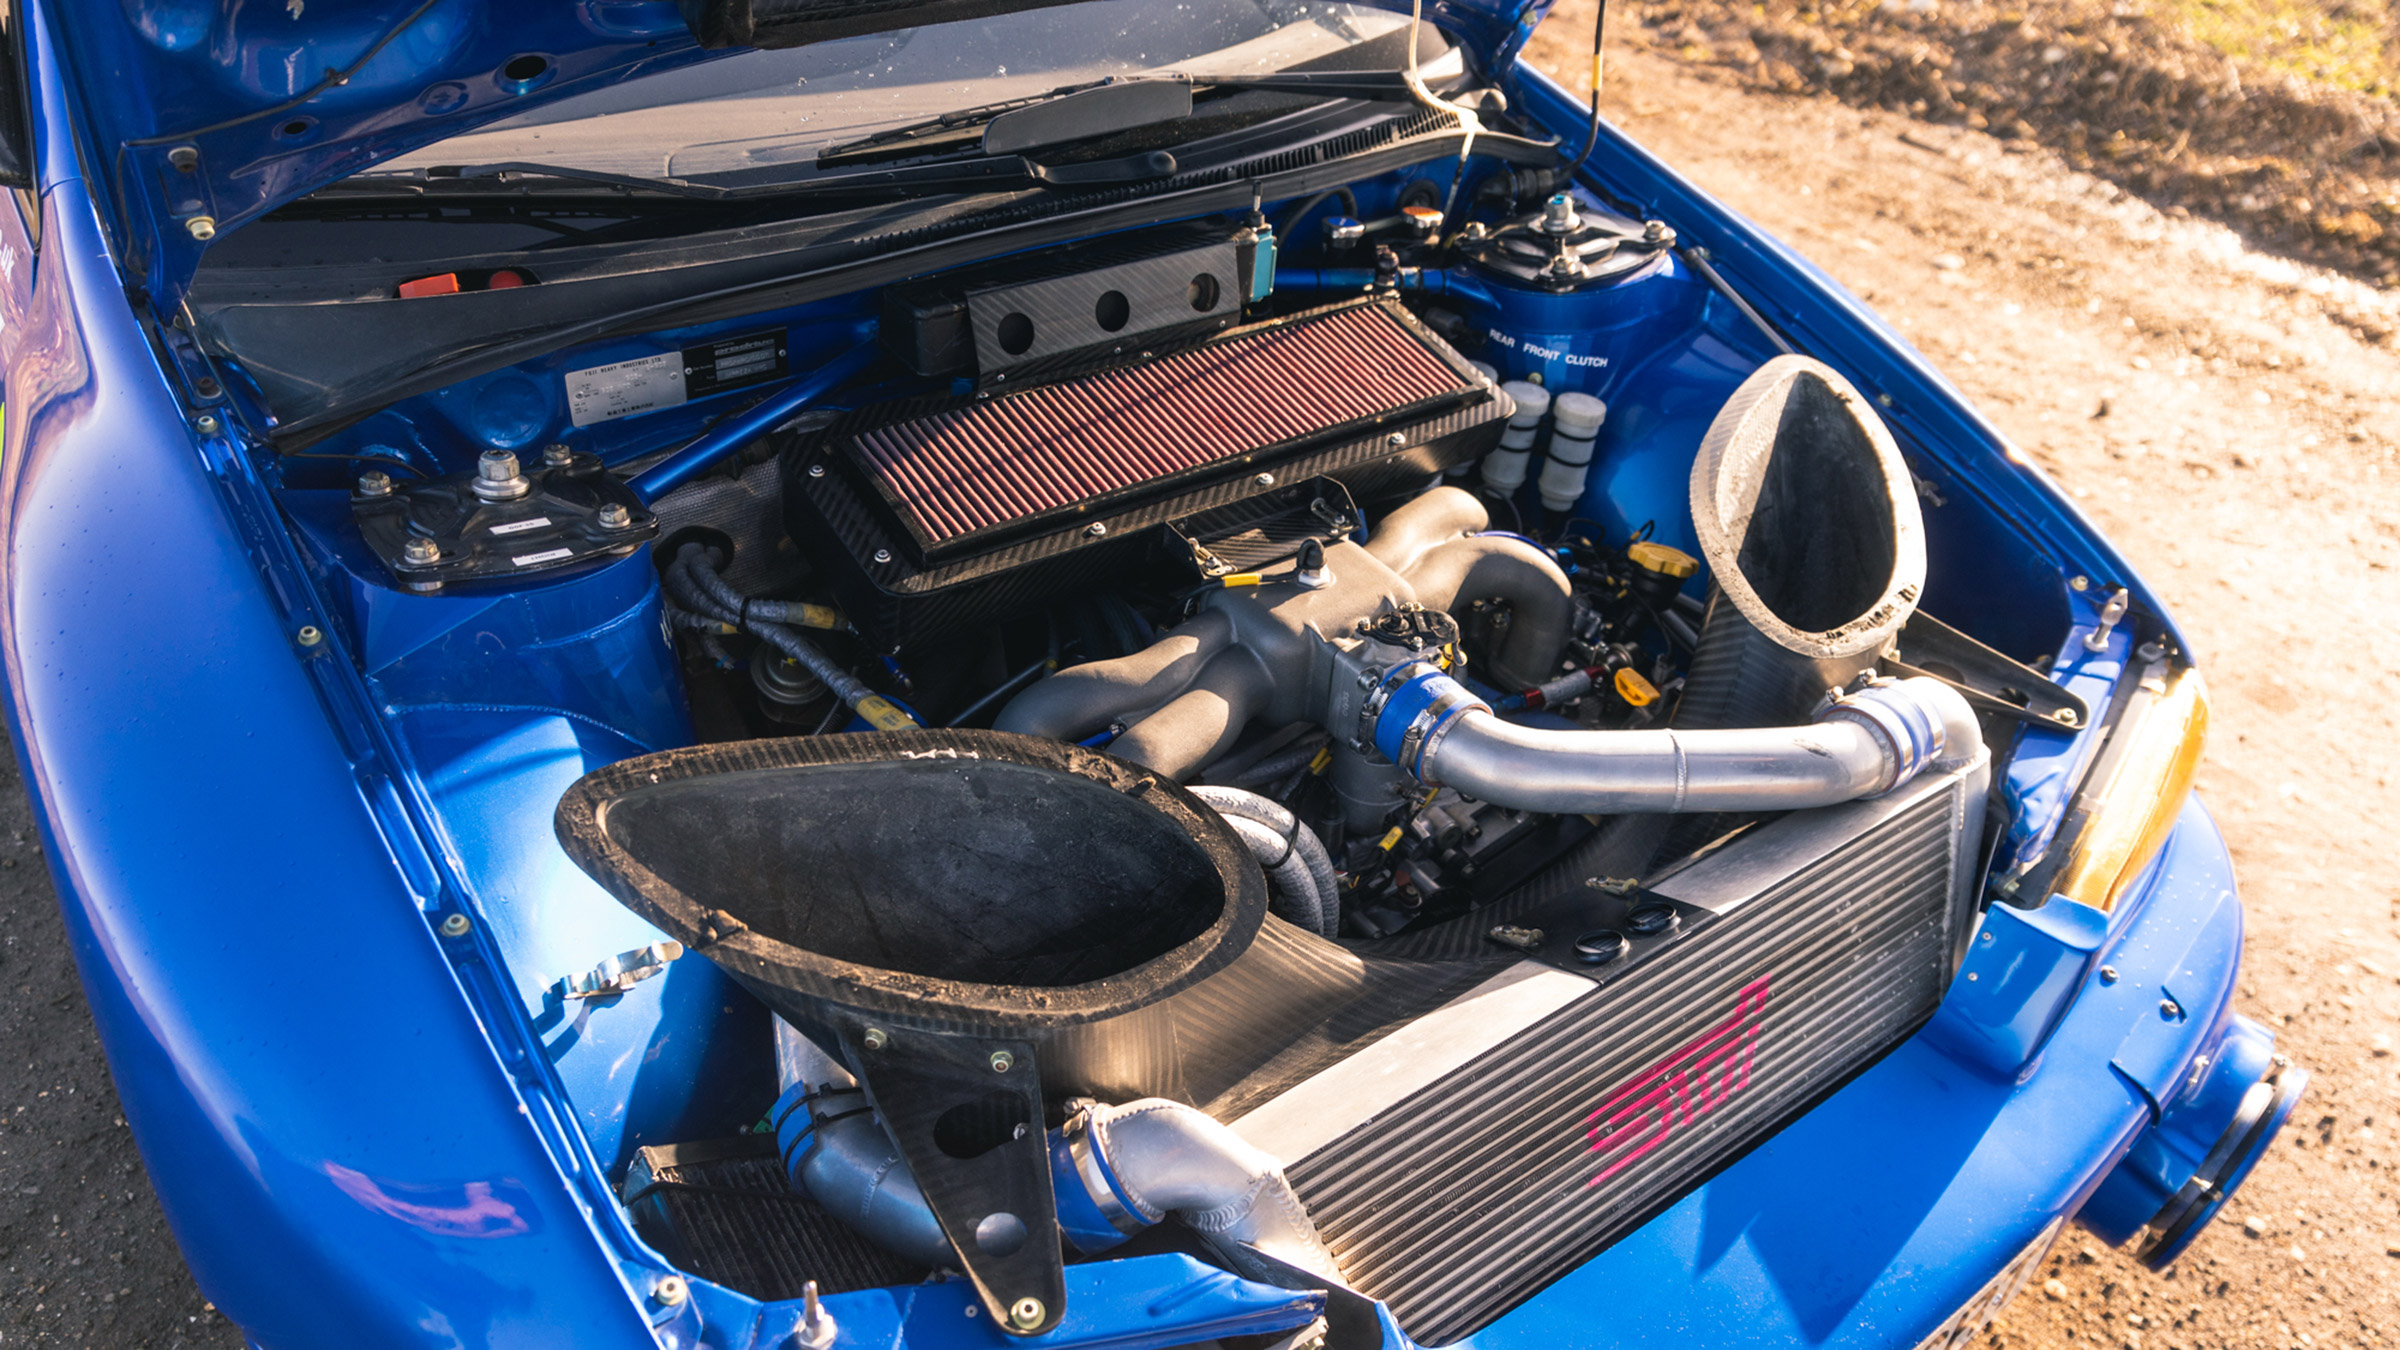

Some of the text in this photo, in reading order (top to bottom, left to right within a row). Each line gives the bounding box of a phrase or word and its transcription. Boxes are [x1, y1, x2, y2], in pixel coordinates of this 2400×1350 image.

[1489, 328, 1608, 367] REAR FRONT CLUTCH
[600, 365, 617, 373] HEAVY
[621, 359, 649, 369] INDUSTRIES
